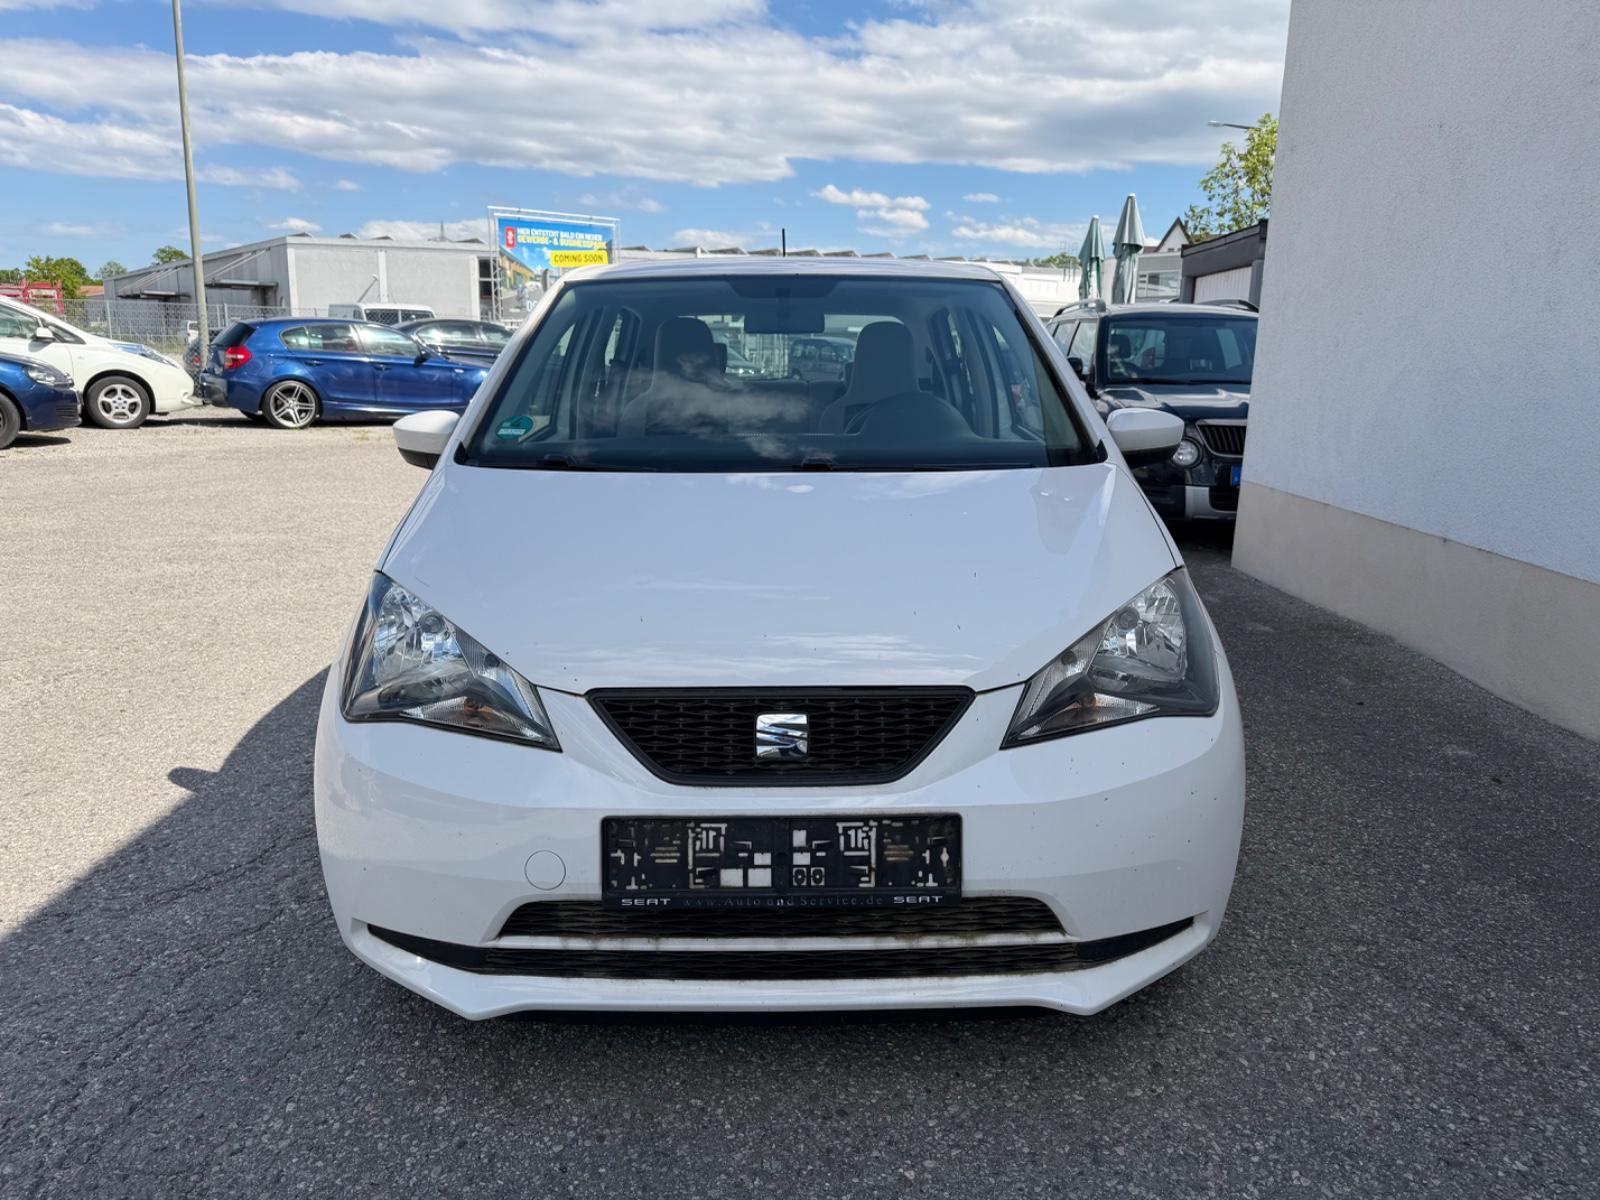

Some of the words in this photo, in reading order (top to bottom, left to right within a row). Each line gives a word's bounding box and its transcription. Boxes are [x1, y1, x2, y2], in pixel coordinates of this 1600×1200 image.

[554, 254, 582, 263] COMING
[584, 254, 604, 263] SOON
[621, 898, 671, 906] SEAT
[893, 895, 943, 904] SEAT
